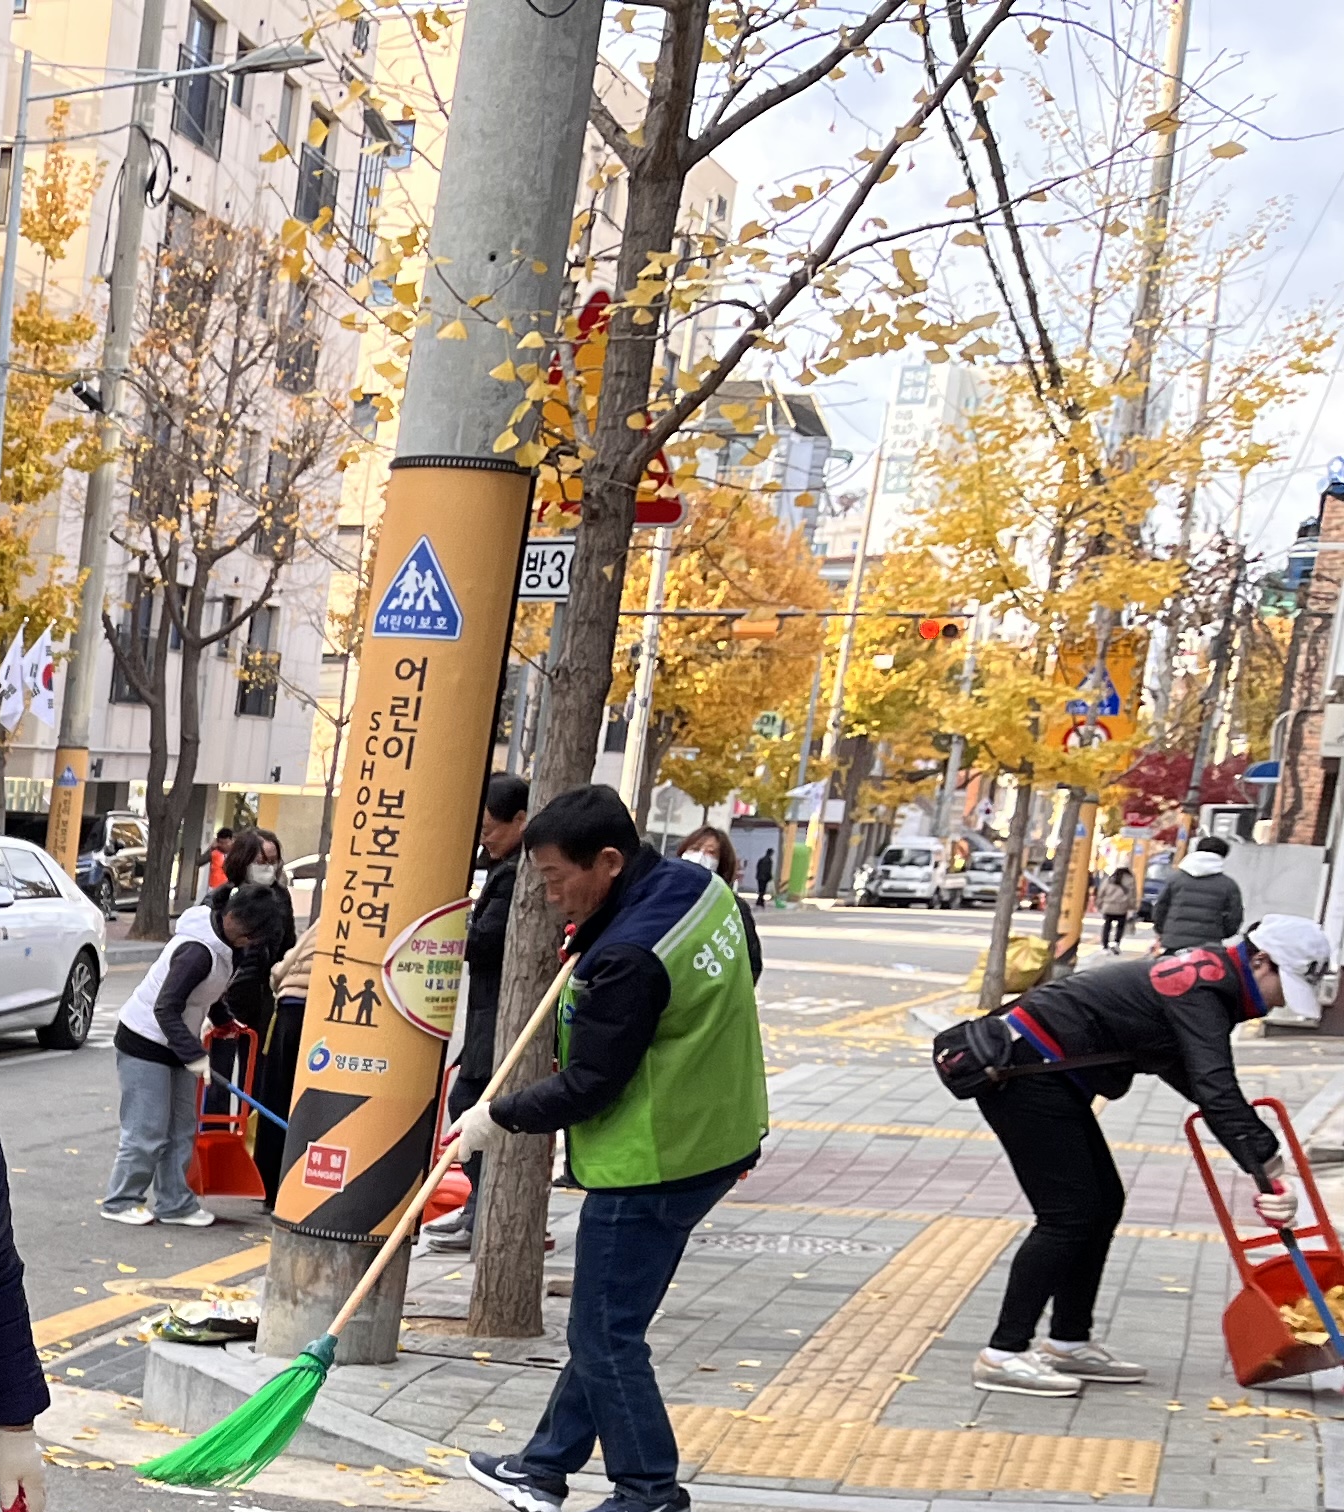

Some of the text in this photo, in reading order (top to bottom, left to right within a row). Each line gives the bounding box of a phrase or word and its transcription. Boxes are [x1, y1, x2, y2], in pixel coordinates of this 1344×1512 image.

[332, 711, 383, 965] SCHOOL ZONE
[355, 656, 429, 939] 어린이 보호구역
[693, 904, 741, 977] 영등포
[335, 1054, 388, 1073] 영등포구
